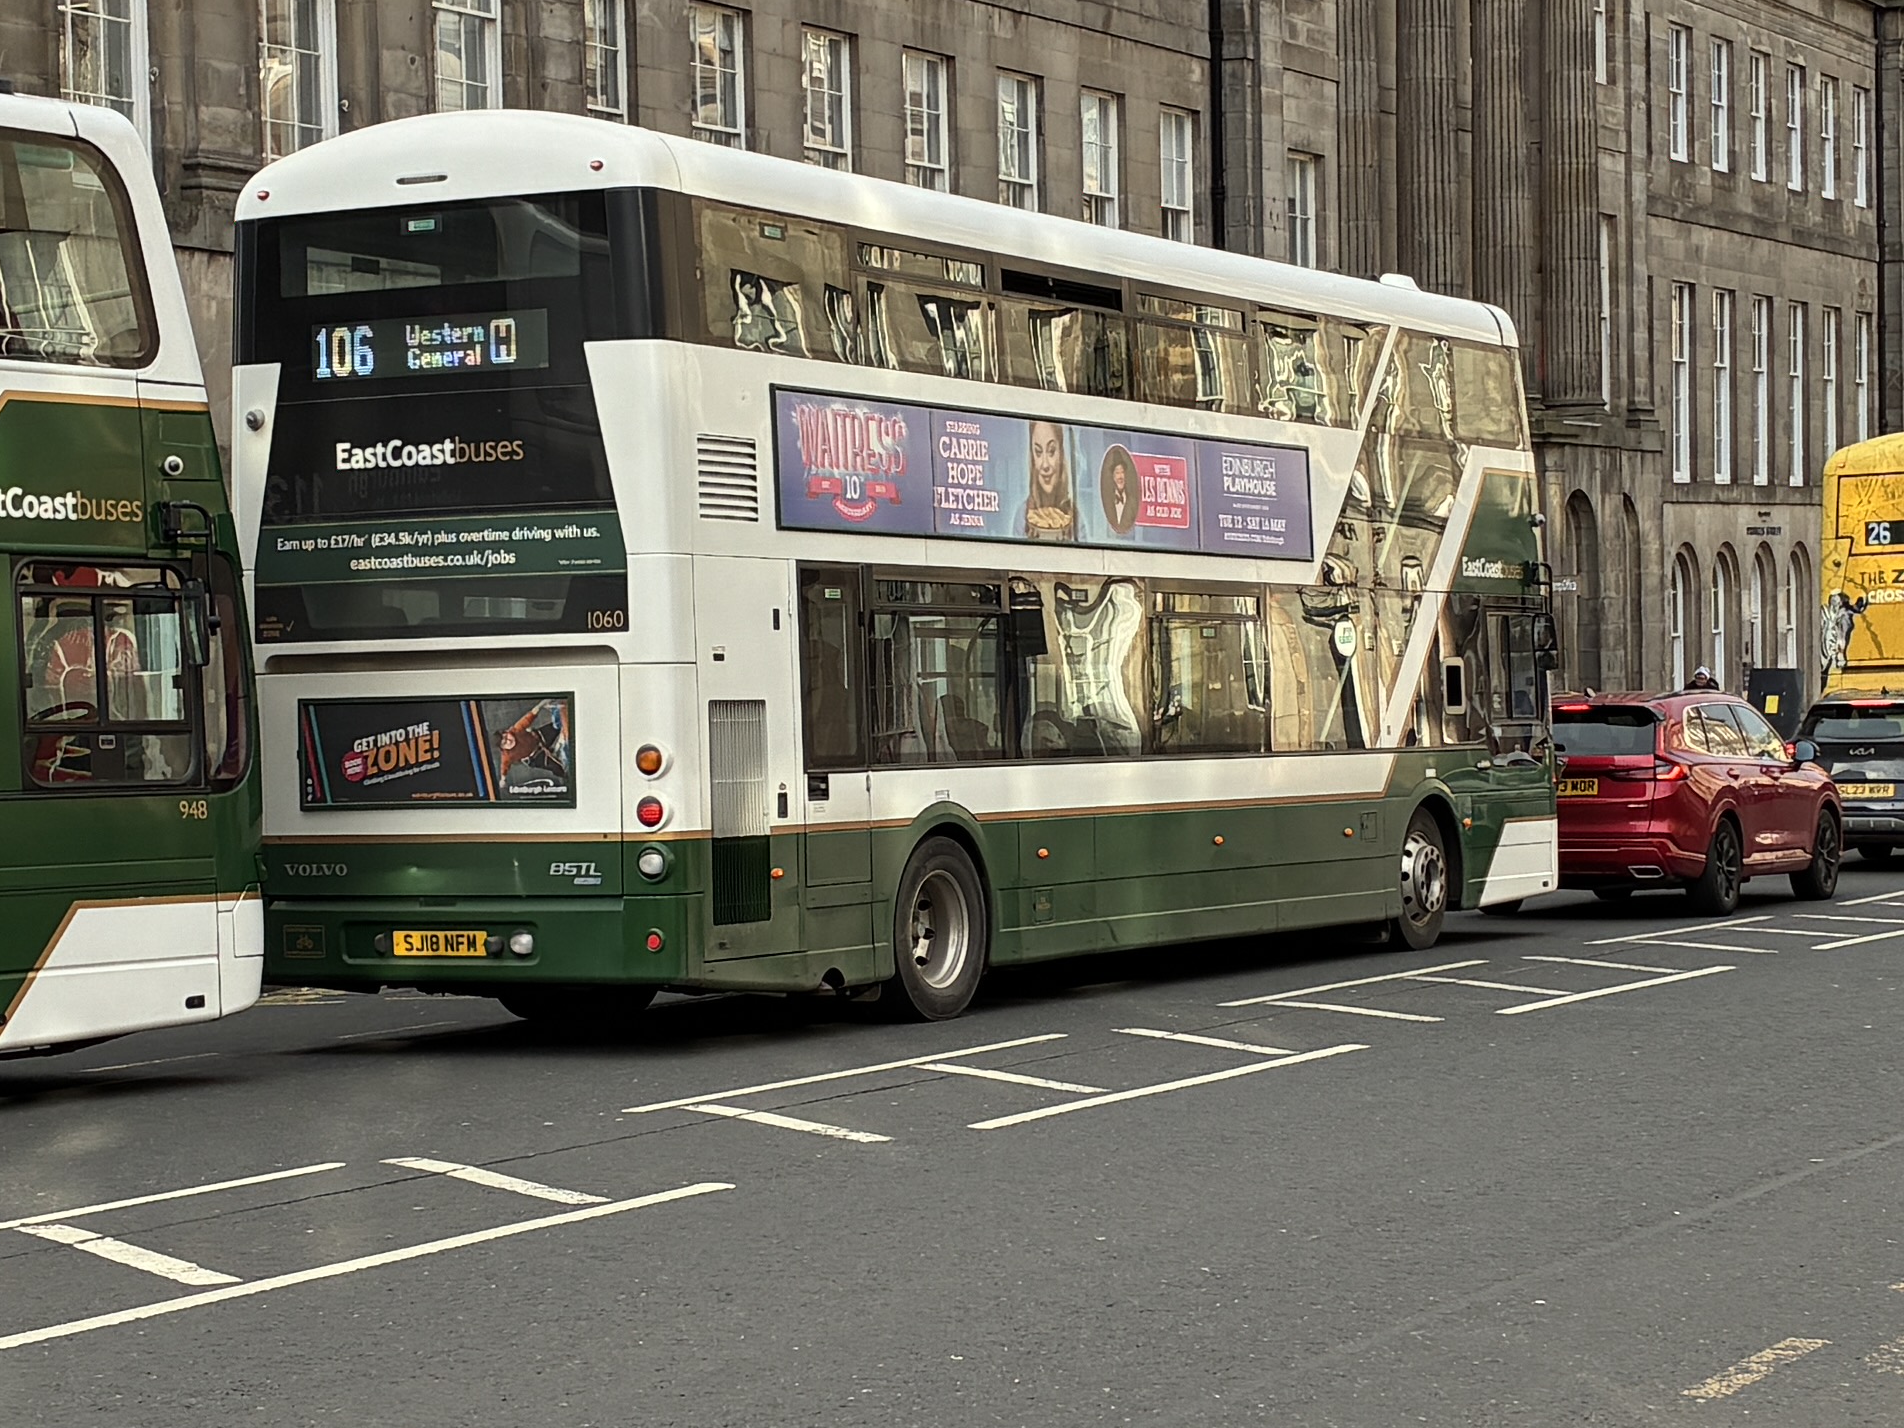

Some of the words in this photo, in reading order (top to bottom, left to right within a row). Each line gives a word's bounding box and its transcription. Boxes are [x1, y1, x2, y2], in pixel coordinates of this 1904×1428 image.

[404, 322, 486, 347] Western
[315, 324, 375, 379] 106
[406, 344, 482, 370] General
[336, 436, 525, 471] EastCoastbuses
[939, 436, 990, 461] CARRIE
[947, 462, 984, 486] HOPE
[1222, 456, 1275, 479] EDINBURGH
[1223, 476, 1277, 496] PLAYHOUSE
[933, 486, 999, 512] FLETCHER
[277, 538, 300, 551] Earn
[301, 539, 315, 552] up
[317, 537, 328, 548] to
[434, 530, 456, 546] plus
[459, 528, 510, 543] overtime
[511, 527, 552, 542] driving
[554, 524, 581, 539] with
[583, 527, 600, 538] us.
[1868, 522, 1891, 545] 26
[350, 549, 517, 570] eastcoastbuses.co.uk/jobs
[1860, 570, 1887, 586] THE
[587, 610, 624, 629] 1060
[353, 735, 376, 752] GET
[377, 728, 406, 747] INTO
[407, 721, 430, 739] THE
[363, 729, 440, 775] ZONE!
[179, 800, 208, 821] 948
[284, 863, 348, 877] VOLVO
[404, 934, 440, 952] SJ18
[445, 932, 477, 952] NFM
